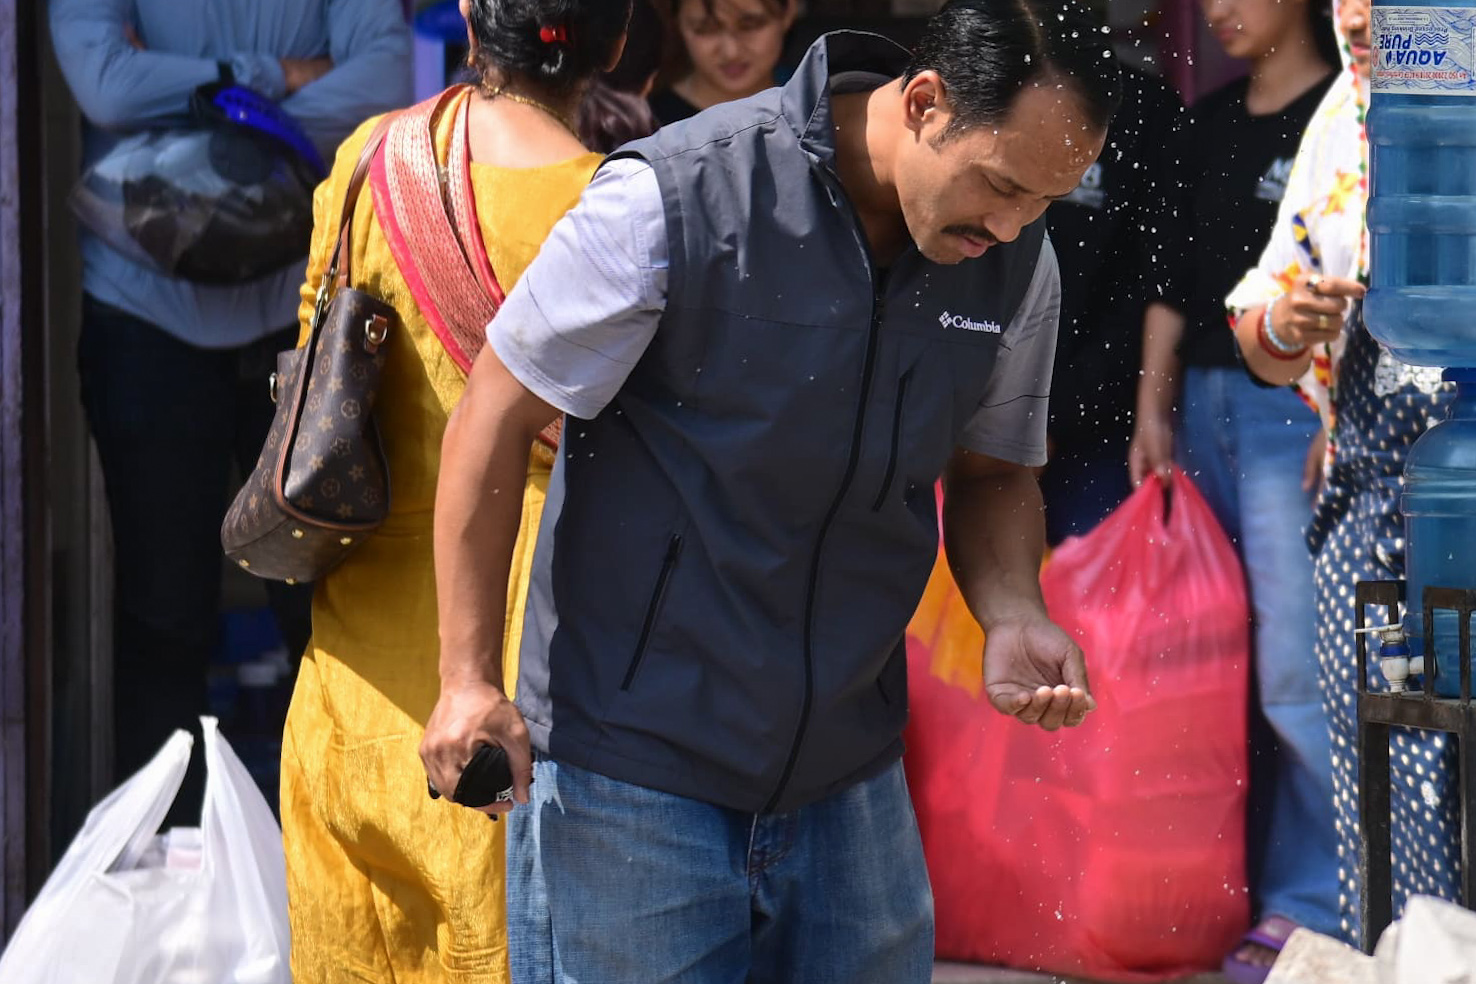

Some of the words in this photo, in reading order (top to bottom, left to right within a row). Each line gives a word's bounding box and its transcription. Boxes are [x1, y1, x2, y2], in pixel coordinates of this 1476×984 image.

[1379, 34, 1412, 50] PURE
[1396, 50, 1447, 65] AQUA
[952, 314, 1001, 334] Columbia
